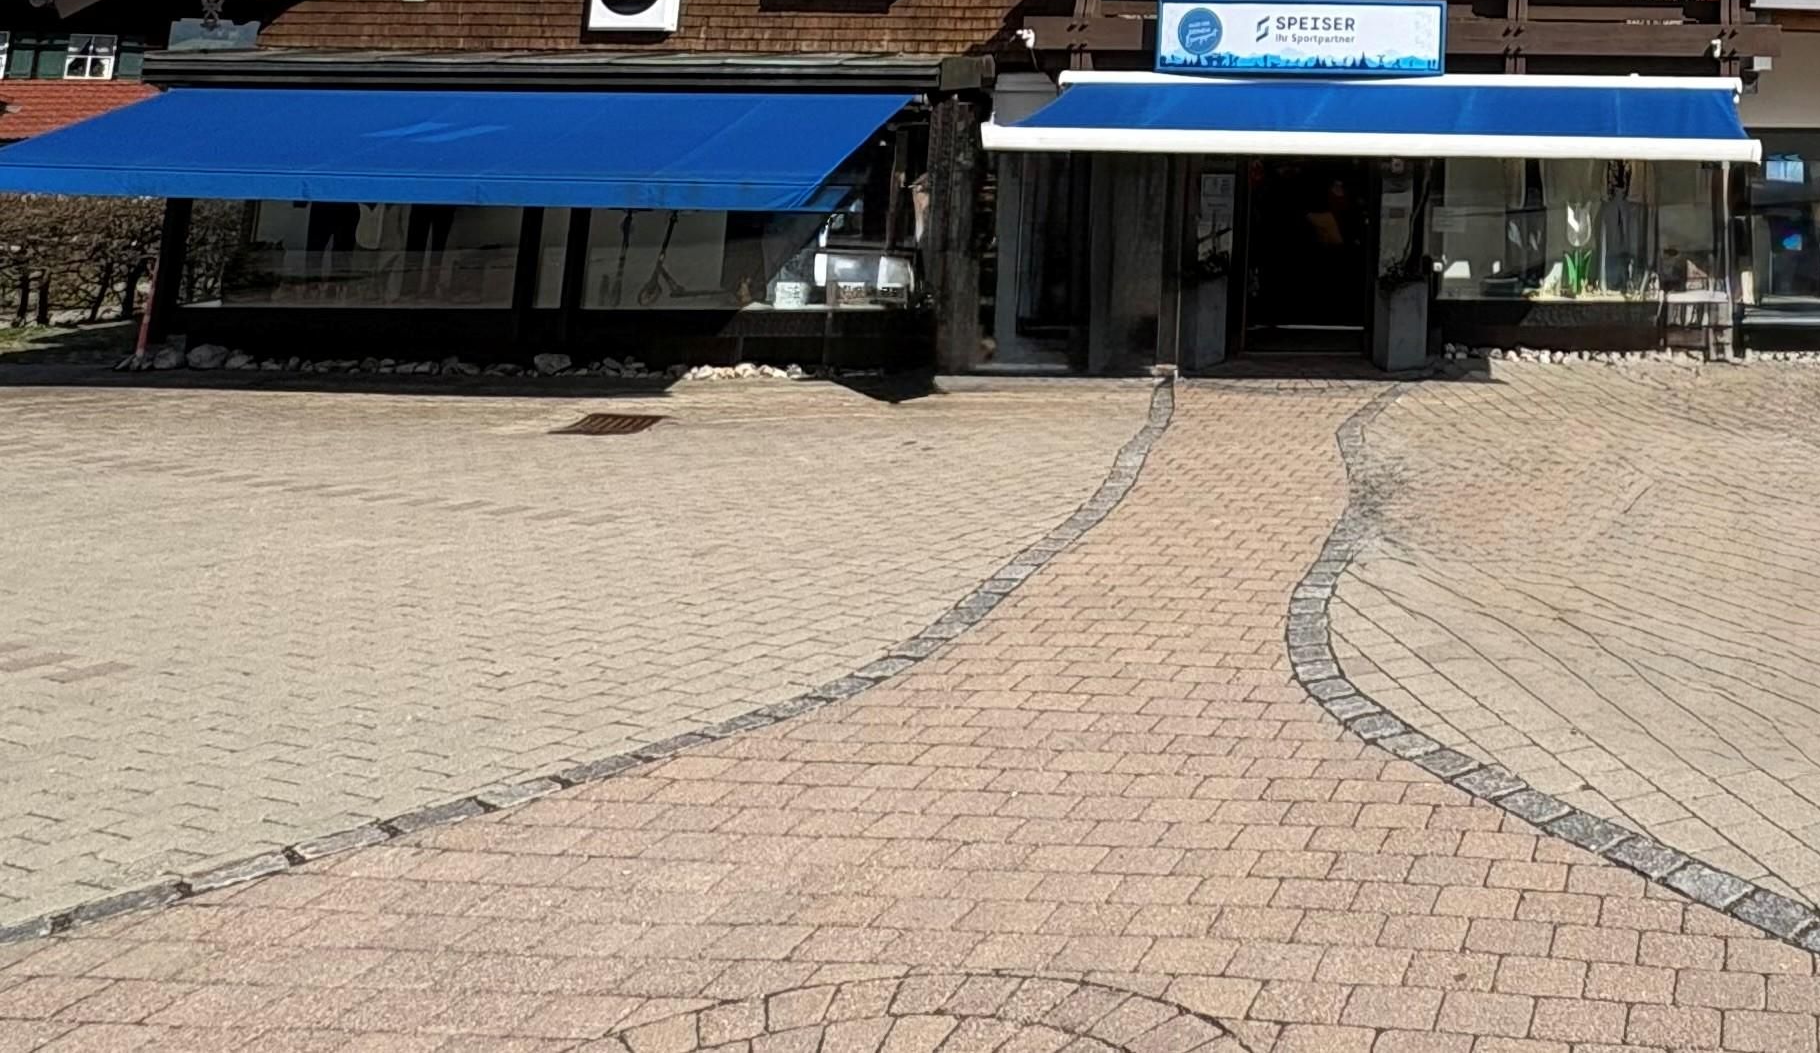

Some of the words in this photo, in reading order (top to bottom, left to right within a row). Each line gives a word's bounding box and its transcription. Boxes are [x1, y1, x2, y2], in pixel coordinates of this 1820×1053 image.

[1276, 16, 1355, 31] SPEISER
[1275, 33, 1288, 42] Ihr
[1291, 33, 1355, 45] Sportpartner
